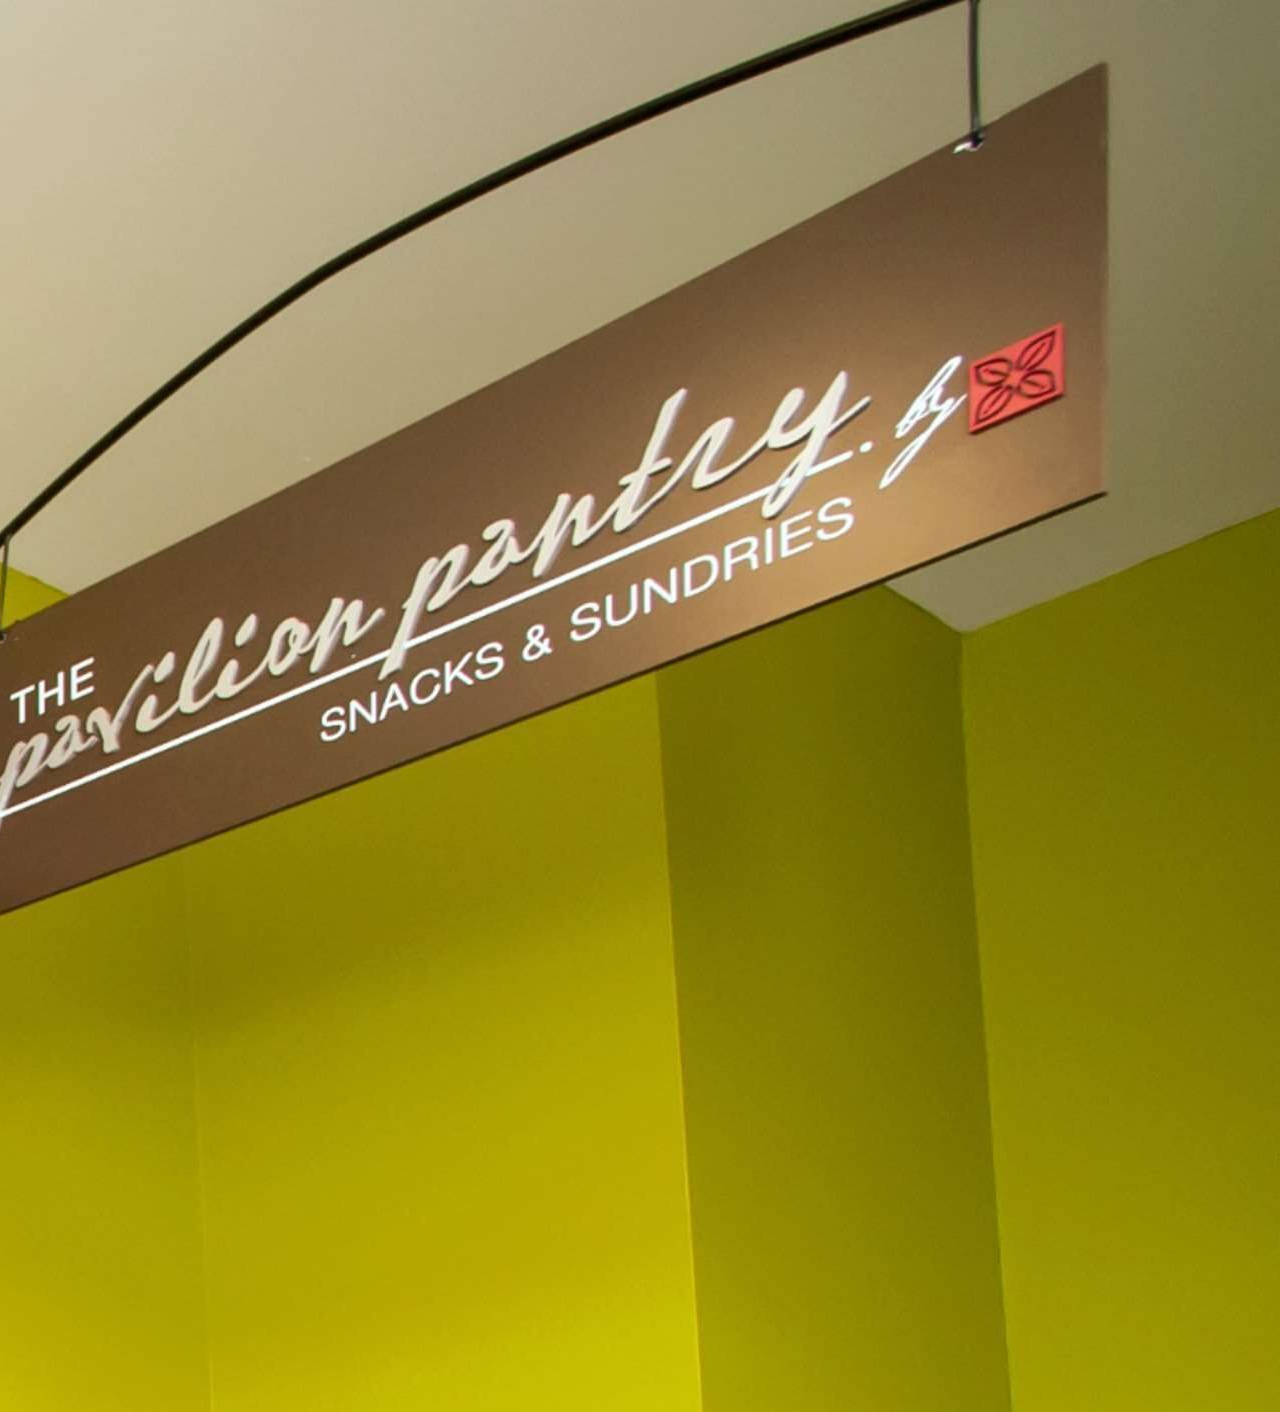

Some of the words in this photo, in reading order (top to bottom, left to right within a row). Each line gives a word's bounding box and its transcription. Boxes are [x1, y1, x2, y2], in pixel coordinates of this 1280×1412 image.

[880, 355, 967, 490] by
[320, 641, 505, 742] SNACKS
[521, 624, 553, 662] &
[569, 496, 855, 643] SUNDRIES
[10, 656, 96, 725] THE
